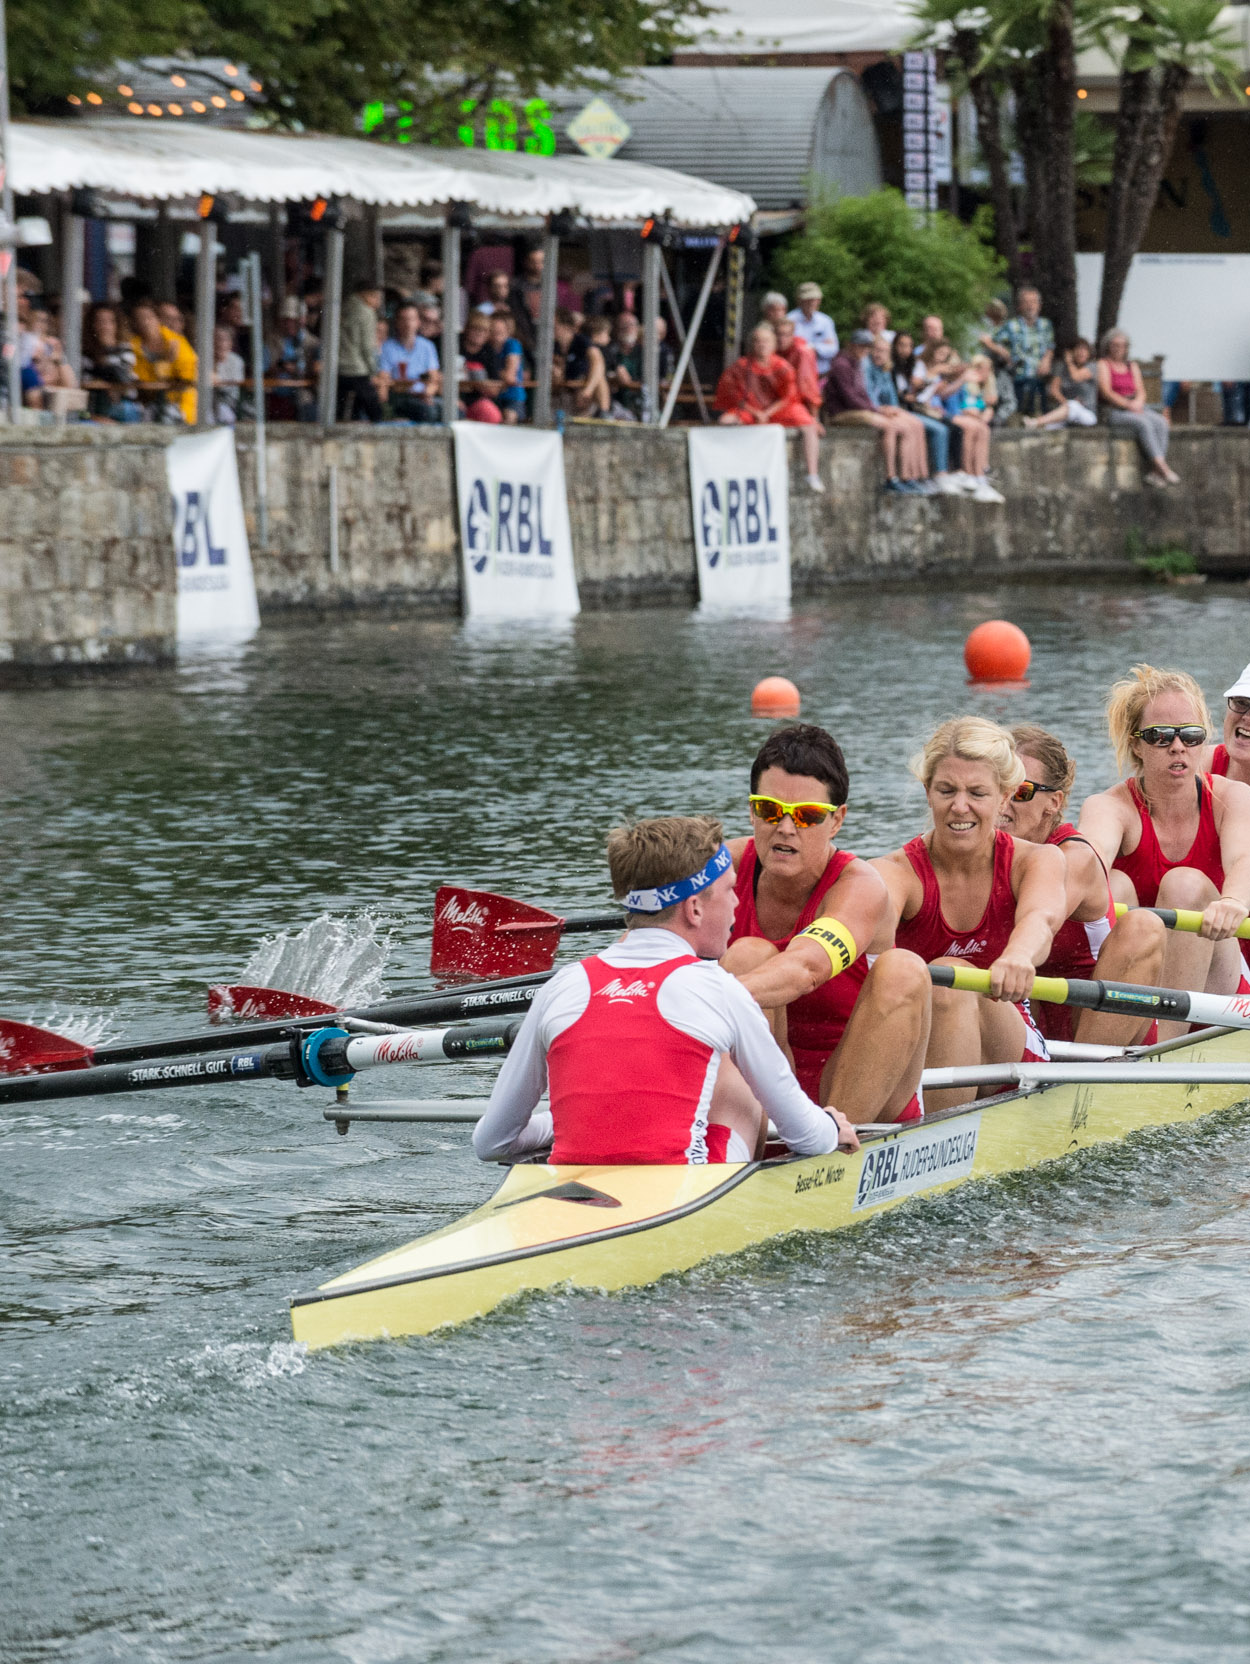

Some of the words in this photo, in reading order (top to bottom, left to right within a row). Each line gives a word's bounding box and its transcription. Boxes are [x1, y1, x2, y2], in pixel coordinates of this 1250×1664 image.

[498, 480, 554, 557] RBL
[725, 476, 778, 546] RBL
[689, 868, 711, 890] NK
[163, 1061, 206, 1079] SCHNELL.
[206, 1059, 228, 1074] GUT.
[237, 1055, 255, 1068] RBL
[872, 1144, 901, 1190] RBL
[900, 1129, 976, 1182] RUDER-BUNDESLIGA
